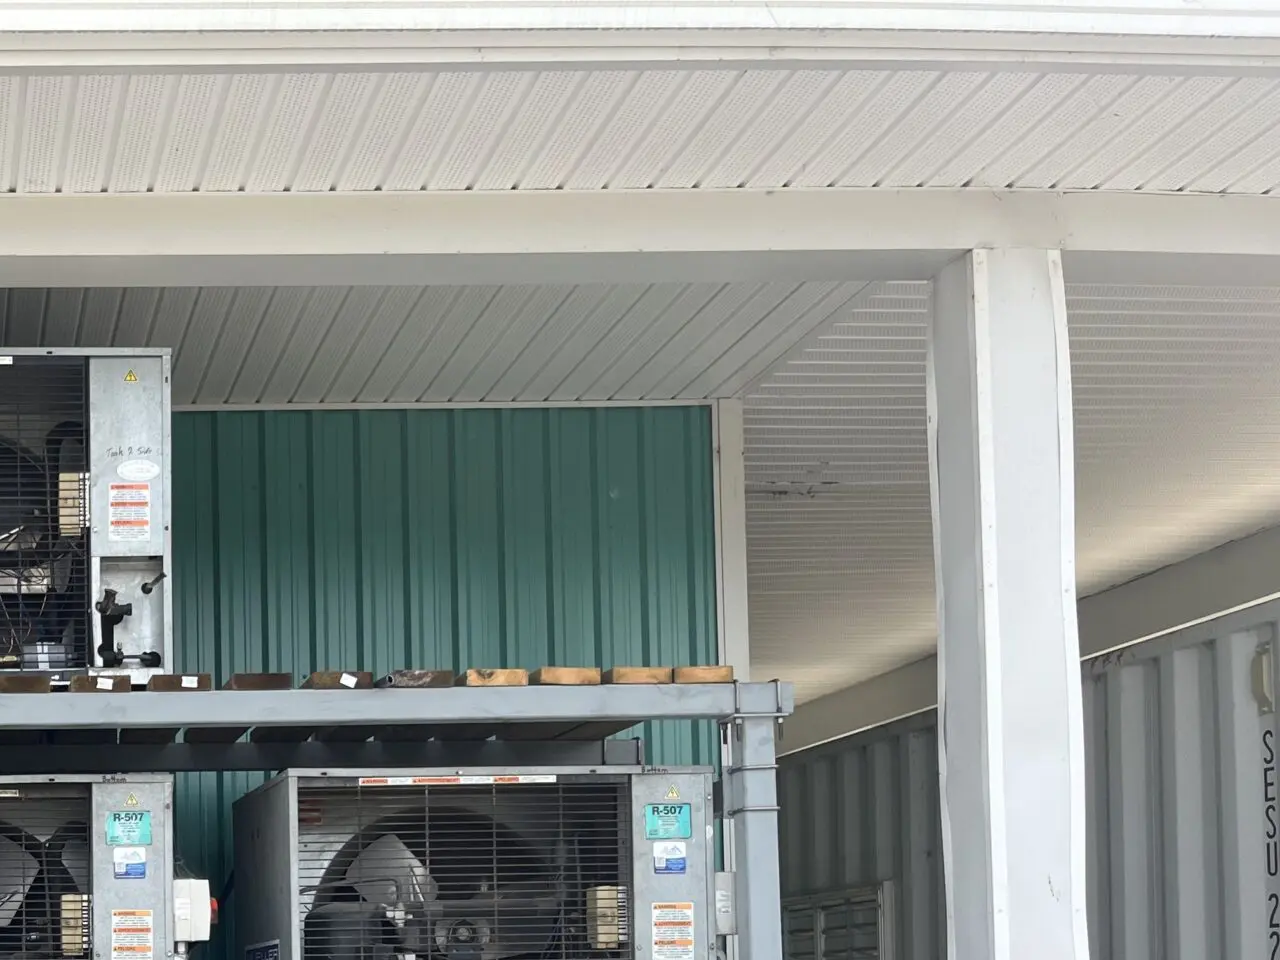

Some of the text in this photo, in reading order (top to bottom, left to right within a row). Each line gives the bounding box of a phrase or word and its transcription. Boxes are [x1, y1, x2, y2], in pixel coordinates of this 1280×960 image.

[1262, 729, 1278, 877] SESU
[652, 805, 684, 816] R-507
[113, 812, 145, 822] R-507
